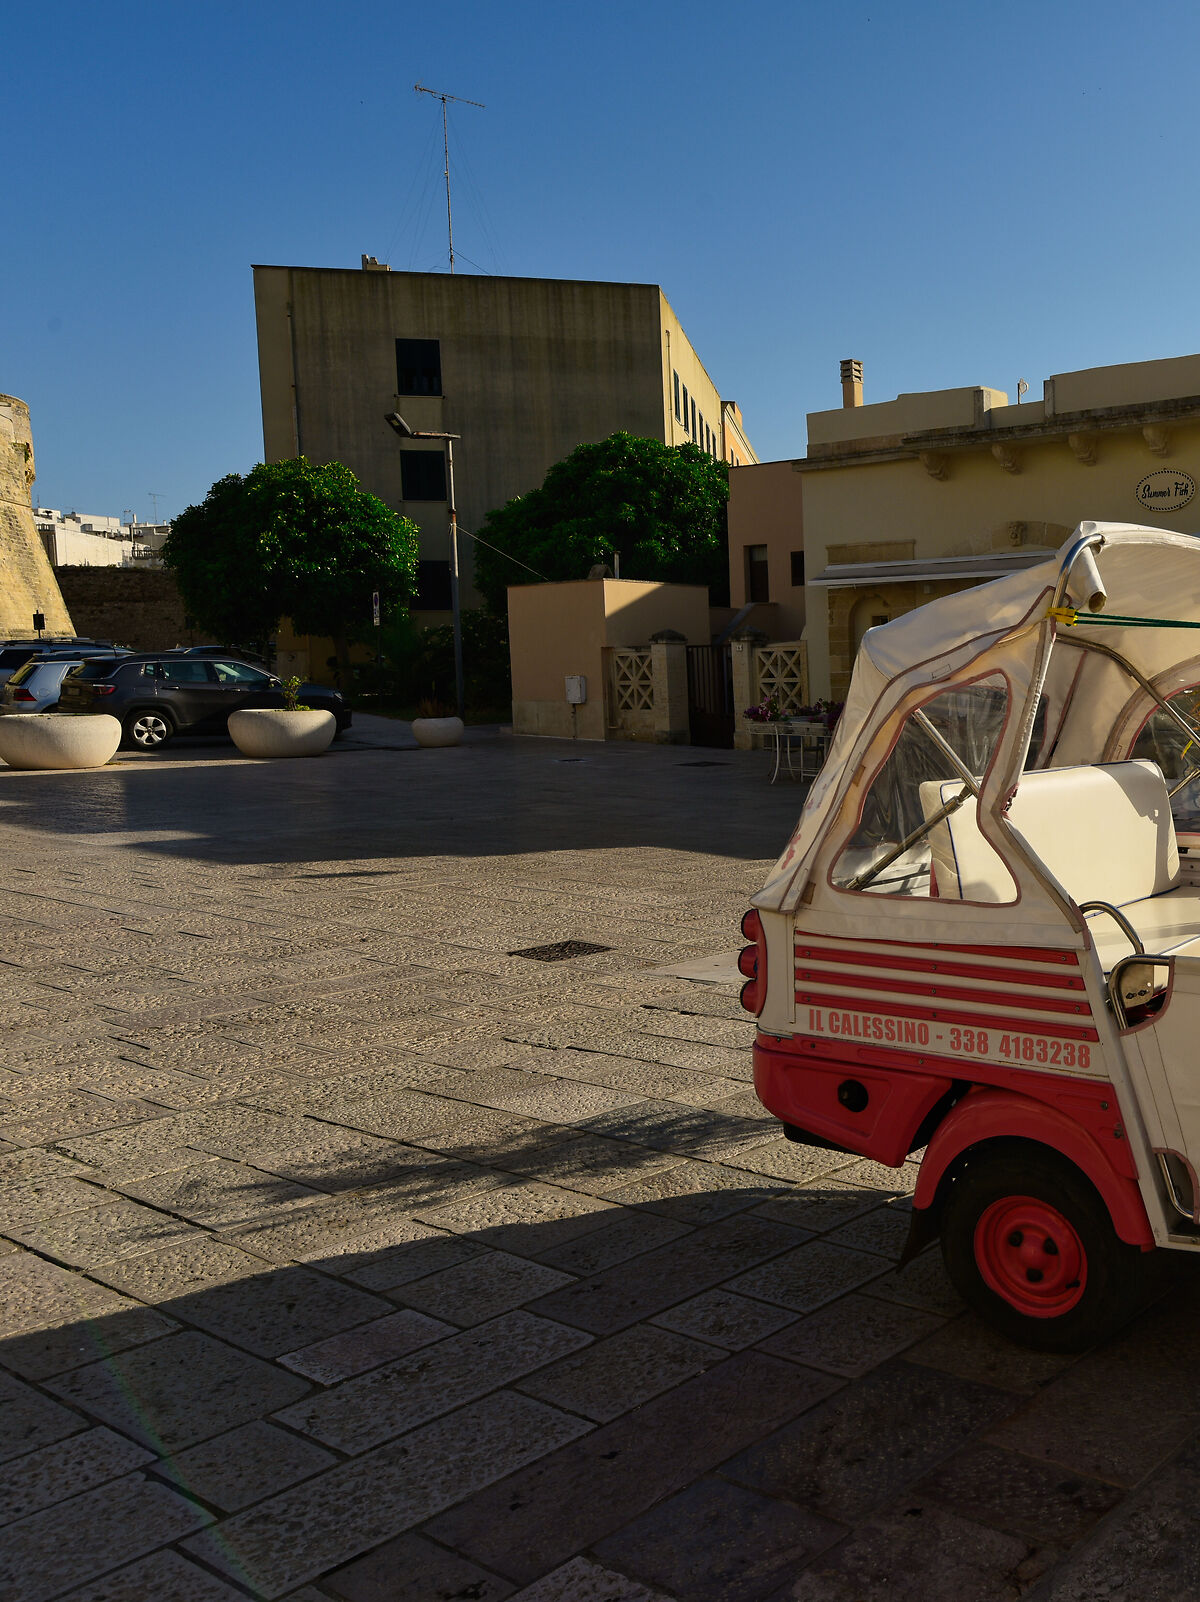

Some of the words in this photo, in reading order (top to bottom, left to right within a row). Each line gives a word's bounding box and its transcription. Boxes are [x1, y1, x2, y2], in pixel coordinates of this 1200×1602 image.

[1174, 481, 1189, 497] Fish
[808, 1008, 824, 1032] IL
[828, 1011, 930, 1046] CALESSINO
[950, 1027, 989, 1055] 338
[999, 1034, 1091, 1069] 4183238
